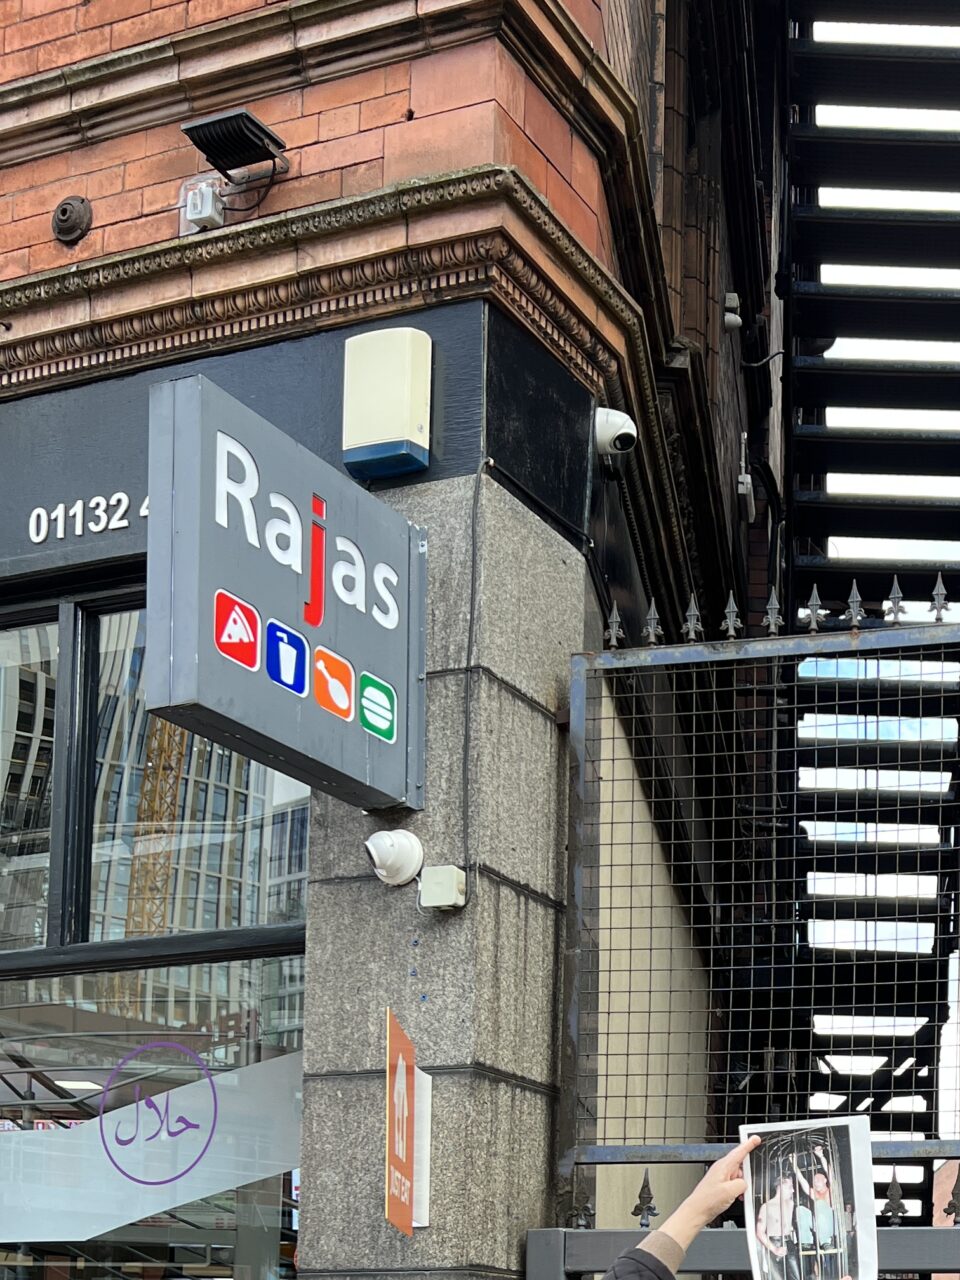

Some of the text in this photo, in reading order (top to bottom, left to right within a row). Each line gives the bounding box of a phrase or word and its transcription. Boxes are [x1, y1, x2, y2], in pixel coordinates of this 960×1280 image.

[29, 492, 129, 543] 01132
[215, 430, 400, 629] Rajas
[115, 1083, 200, 1146] حلال
[389, 1164, 411, 1206] JUST EAT
